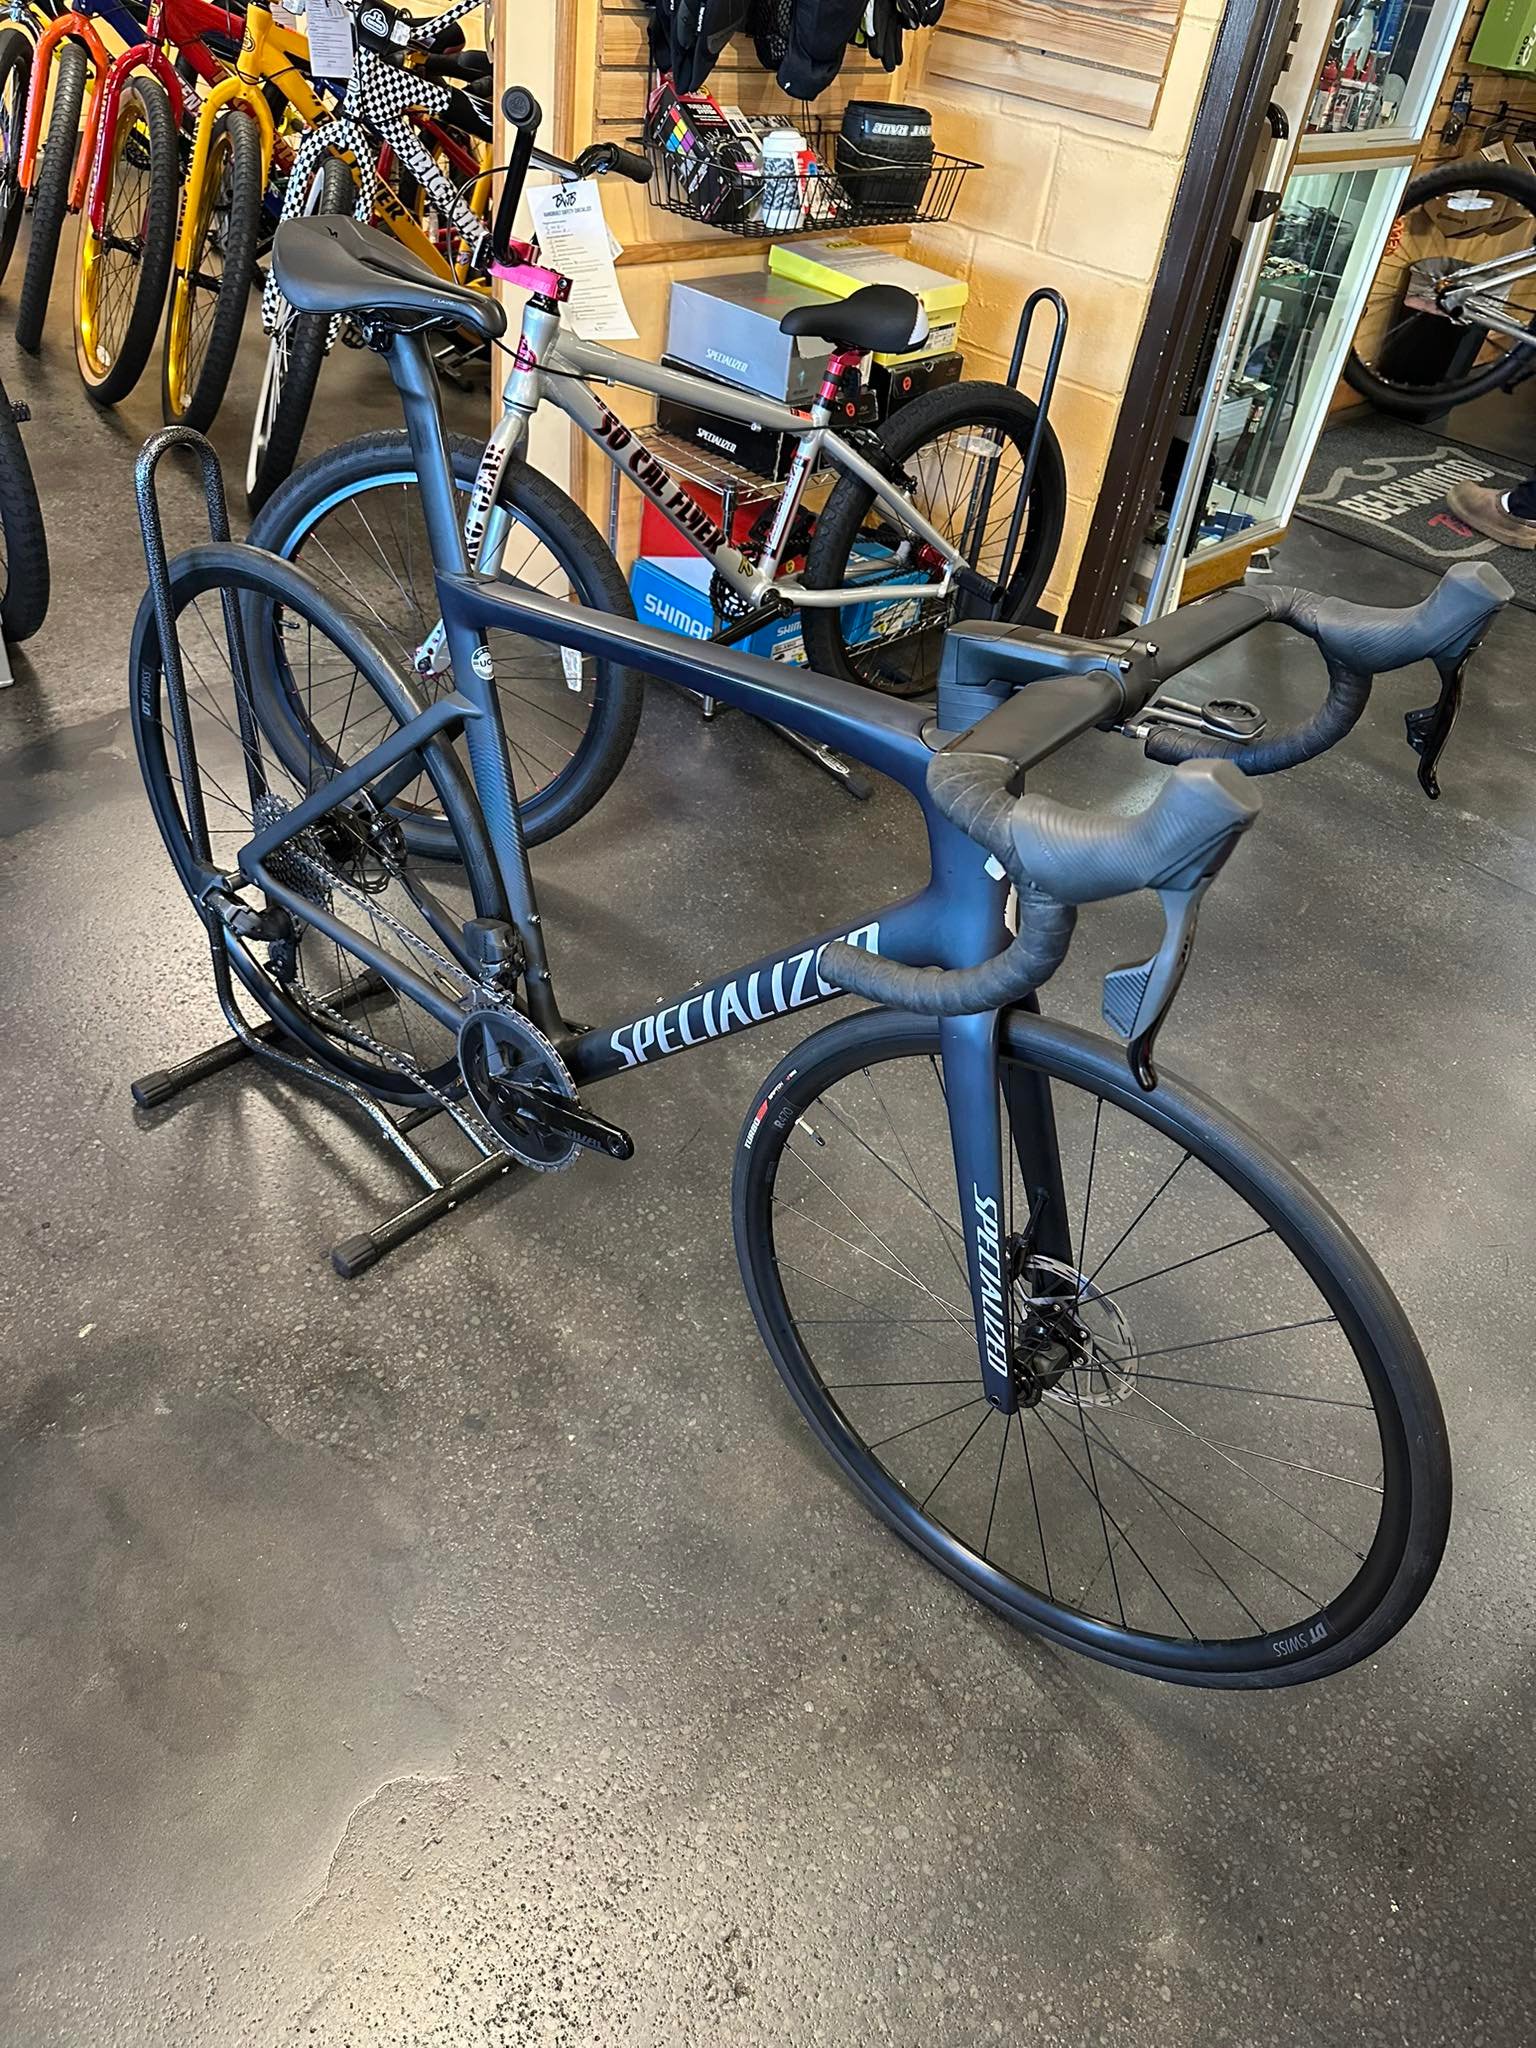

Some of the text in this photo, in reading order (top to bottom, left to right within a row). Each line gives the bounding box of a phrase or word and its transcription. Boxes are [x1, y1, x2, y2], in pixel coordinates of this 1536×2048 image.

[409, 152, 458, 201] BIG
[705, 347, 749, 374] SPECIALIZED
[696, 427, 738, 454] SPECIALIZED
[628, 446, 671, 497] CAL
[665, 489, 726, 555] FLYER
[1337, 459, 1496, 521] BEACHWOOD
[141, 697, 151, 716] DT
[744, 1117, 760, 1150] TURBO
[773, 1106, 794, 1129] R470
[973, 1182, 1009, 1378] SPECIALIZED
[1272, 1622, 1328, 1657] DT SWISS
